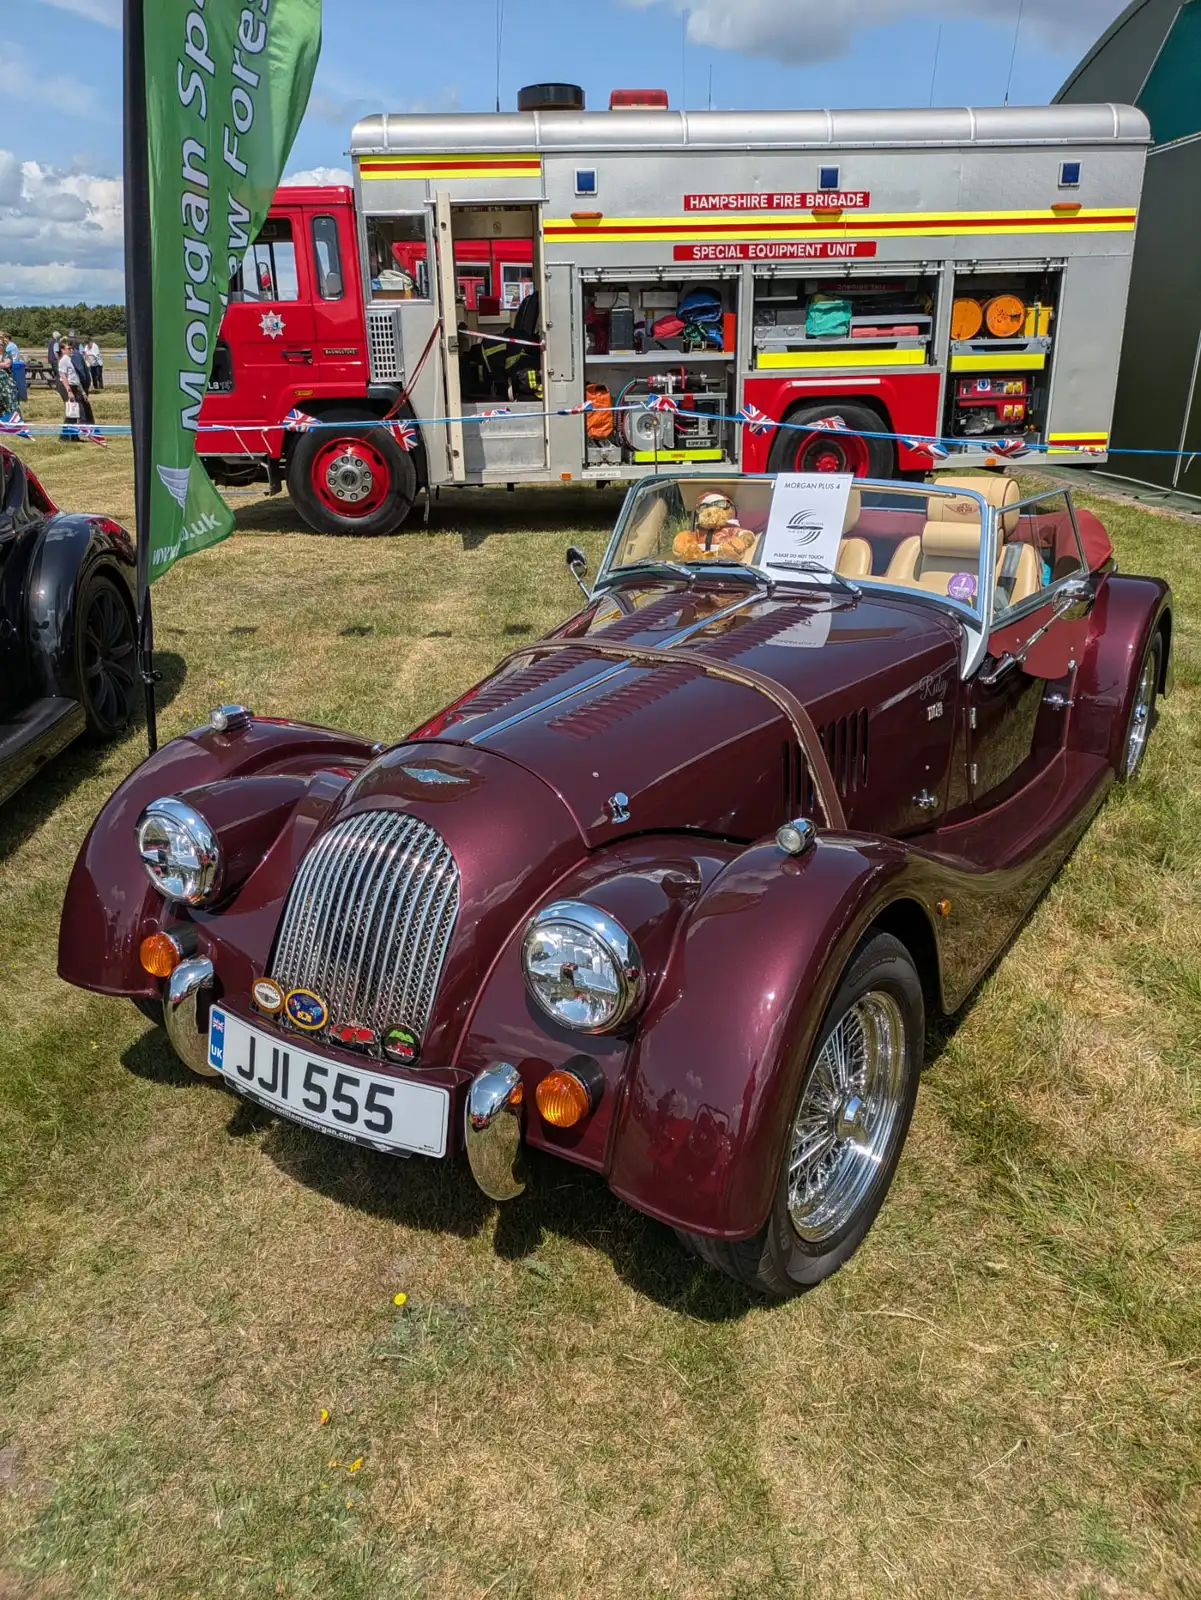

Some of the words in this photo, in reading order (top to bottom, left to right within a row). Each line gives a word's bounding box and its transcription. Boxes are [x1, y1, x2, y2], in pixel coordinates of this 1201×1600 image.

[690, 195, 768, 209] HAMPSHIRE
[773, 194, 801, 208] FIRE
[806, 193, 864, 207] BRIGADE
[692, 245, 744, 259] SPECIAL
[748, 244, 823, 258] EQUIPMENT
[827, 243, 857, 257] UNIT
[179, 136, 213, 433] Morgan
[784, 482, 818, 490] MORGAN
[210, 1044, 223, 1061] UK
[236, 1035, 290, 1100] JJI
[302, 1062, 395, 1135] 555
[258, 1096, 357, 1143] www.williamsmorgan.com
